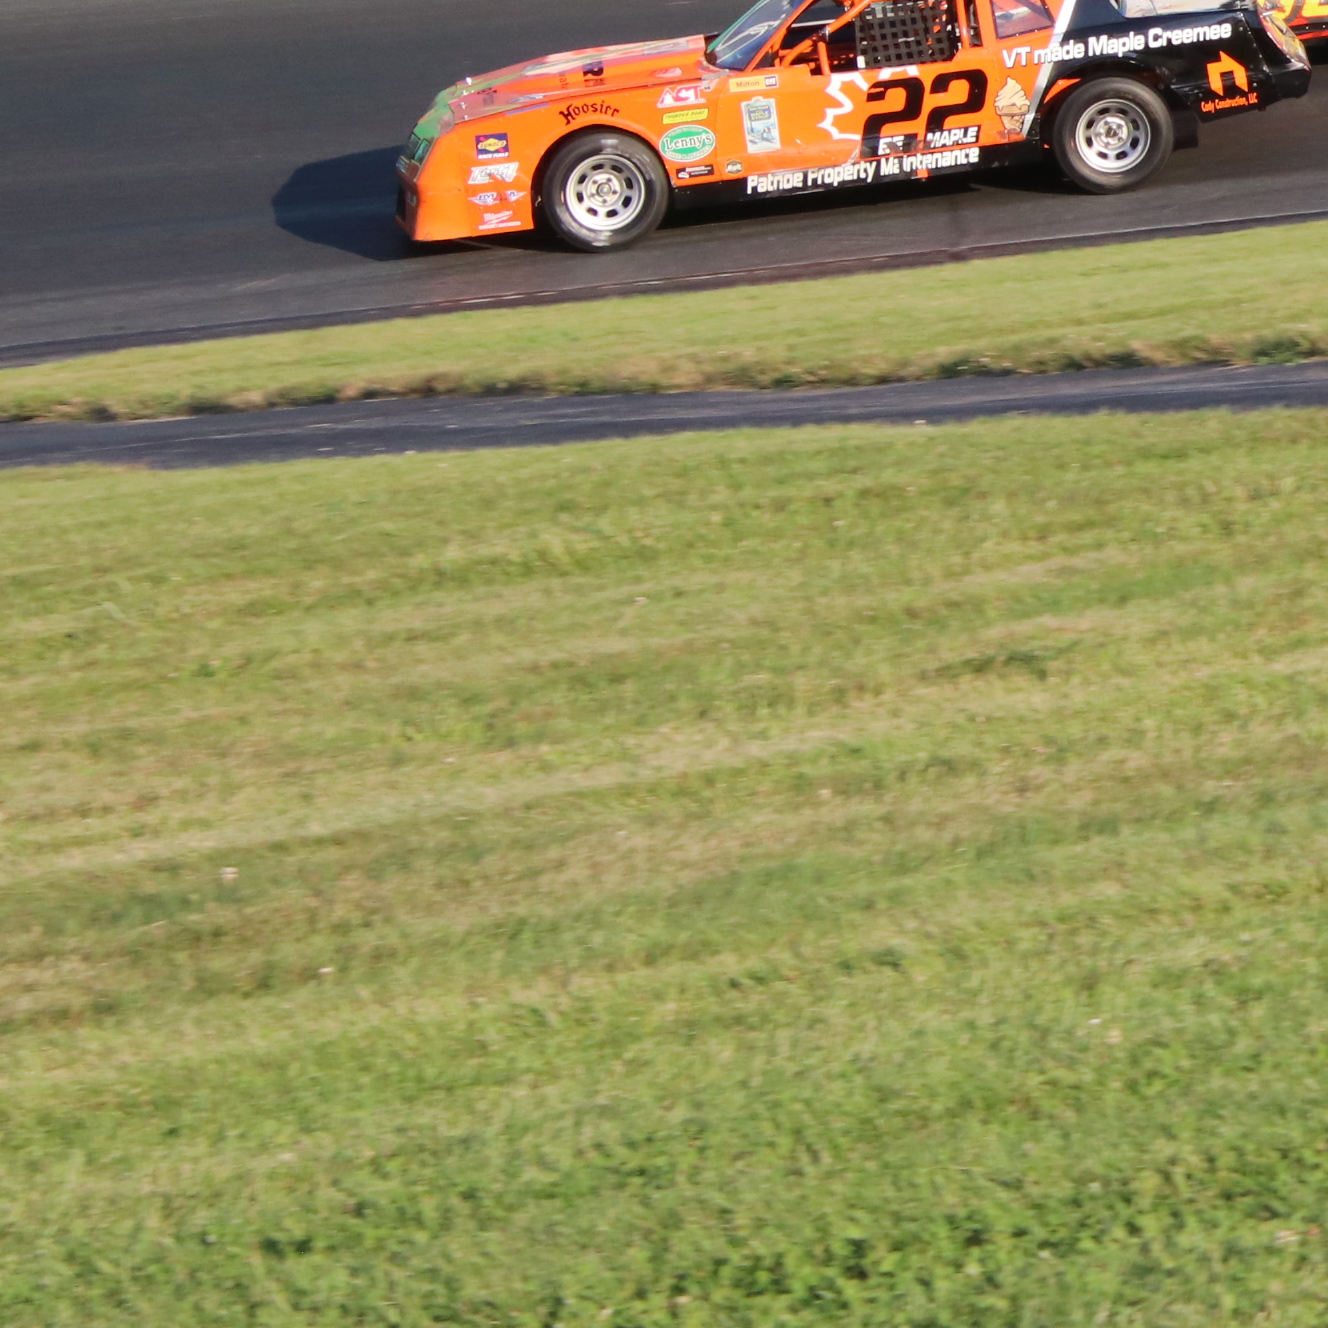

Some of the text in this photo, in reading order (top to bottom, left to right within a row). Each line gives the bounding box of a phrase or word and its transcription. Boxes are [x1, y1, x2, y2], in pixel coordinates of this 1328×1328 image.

[1002, 22, 1232, 69] VT made Maple Creemee
[659, 84, 702, 106] ACT
[735, 81, 760, 89] Milton
[559, 100, 620, 126] Hoosier
[860, 68, 989, 158] 22
[478, 140, 507, 150] SUNOCO
[664, 132, 713, 151] Lenny's
[927, 125, 979, 149] MAPLE
[807, 160, 877, 187] Property
[880, 146, 980, 176] Maintenance
